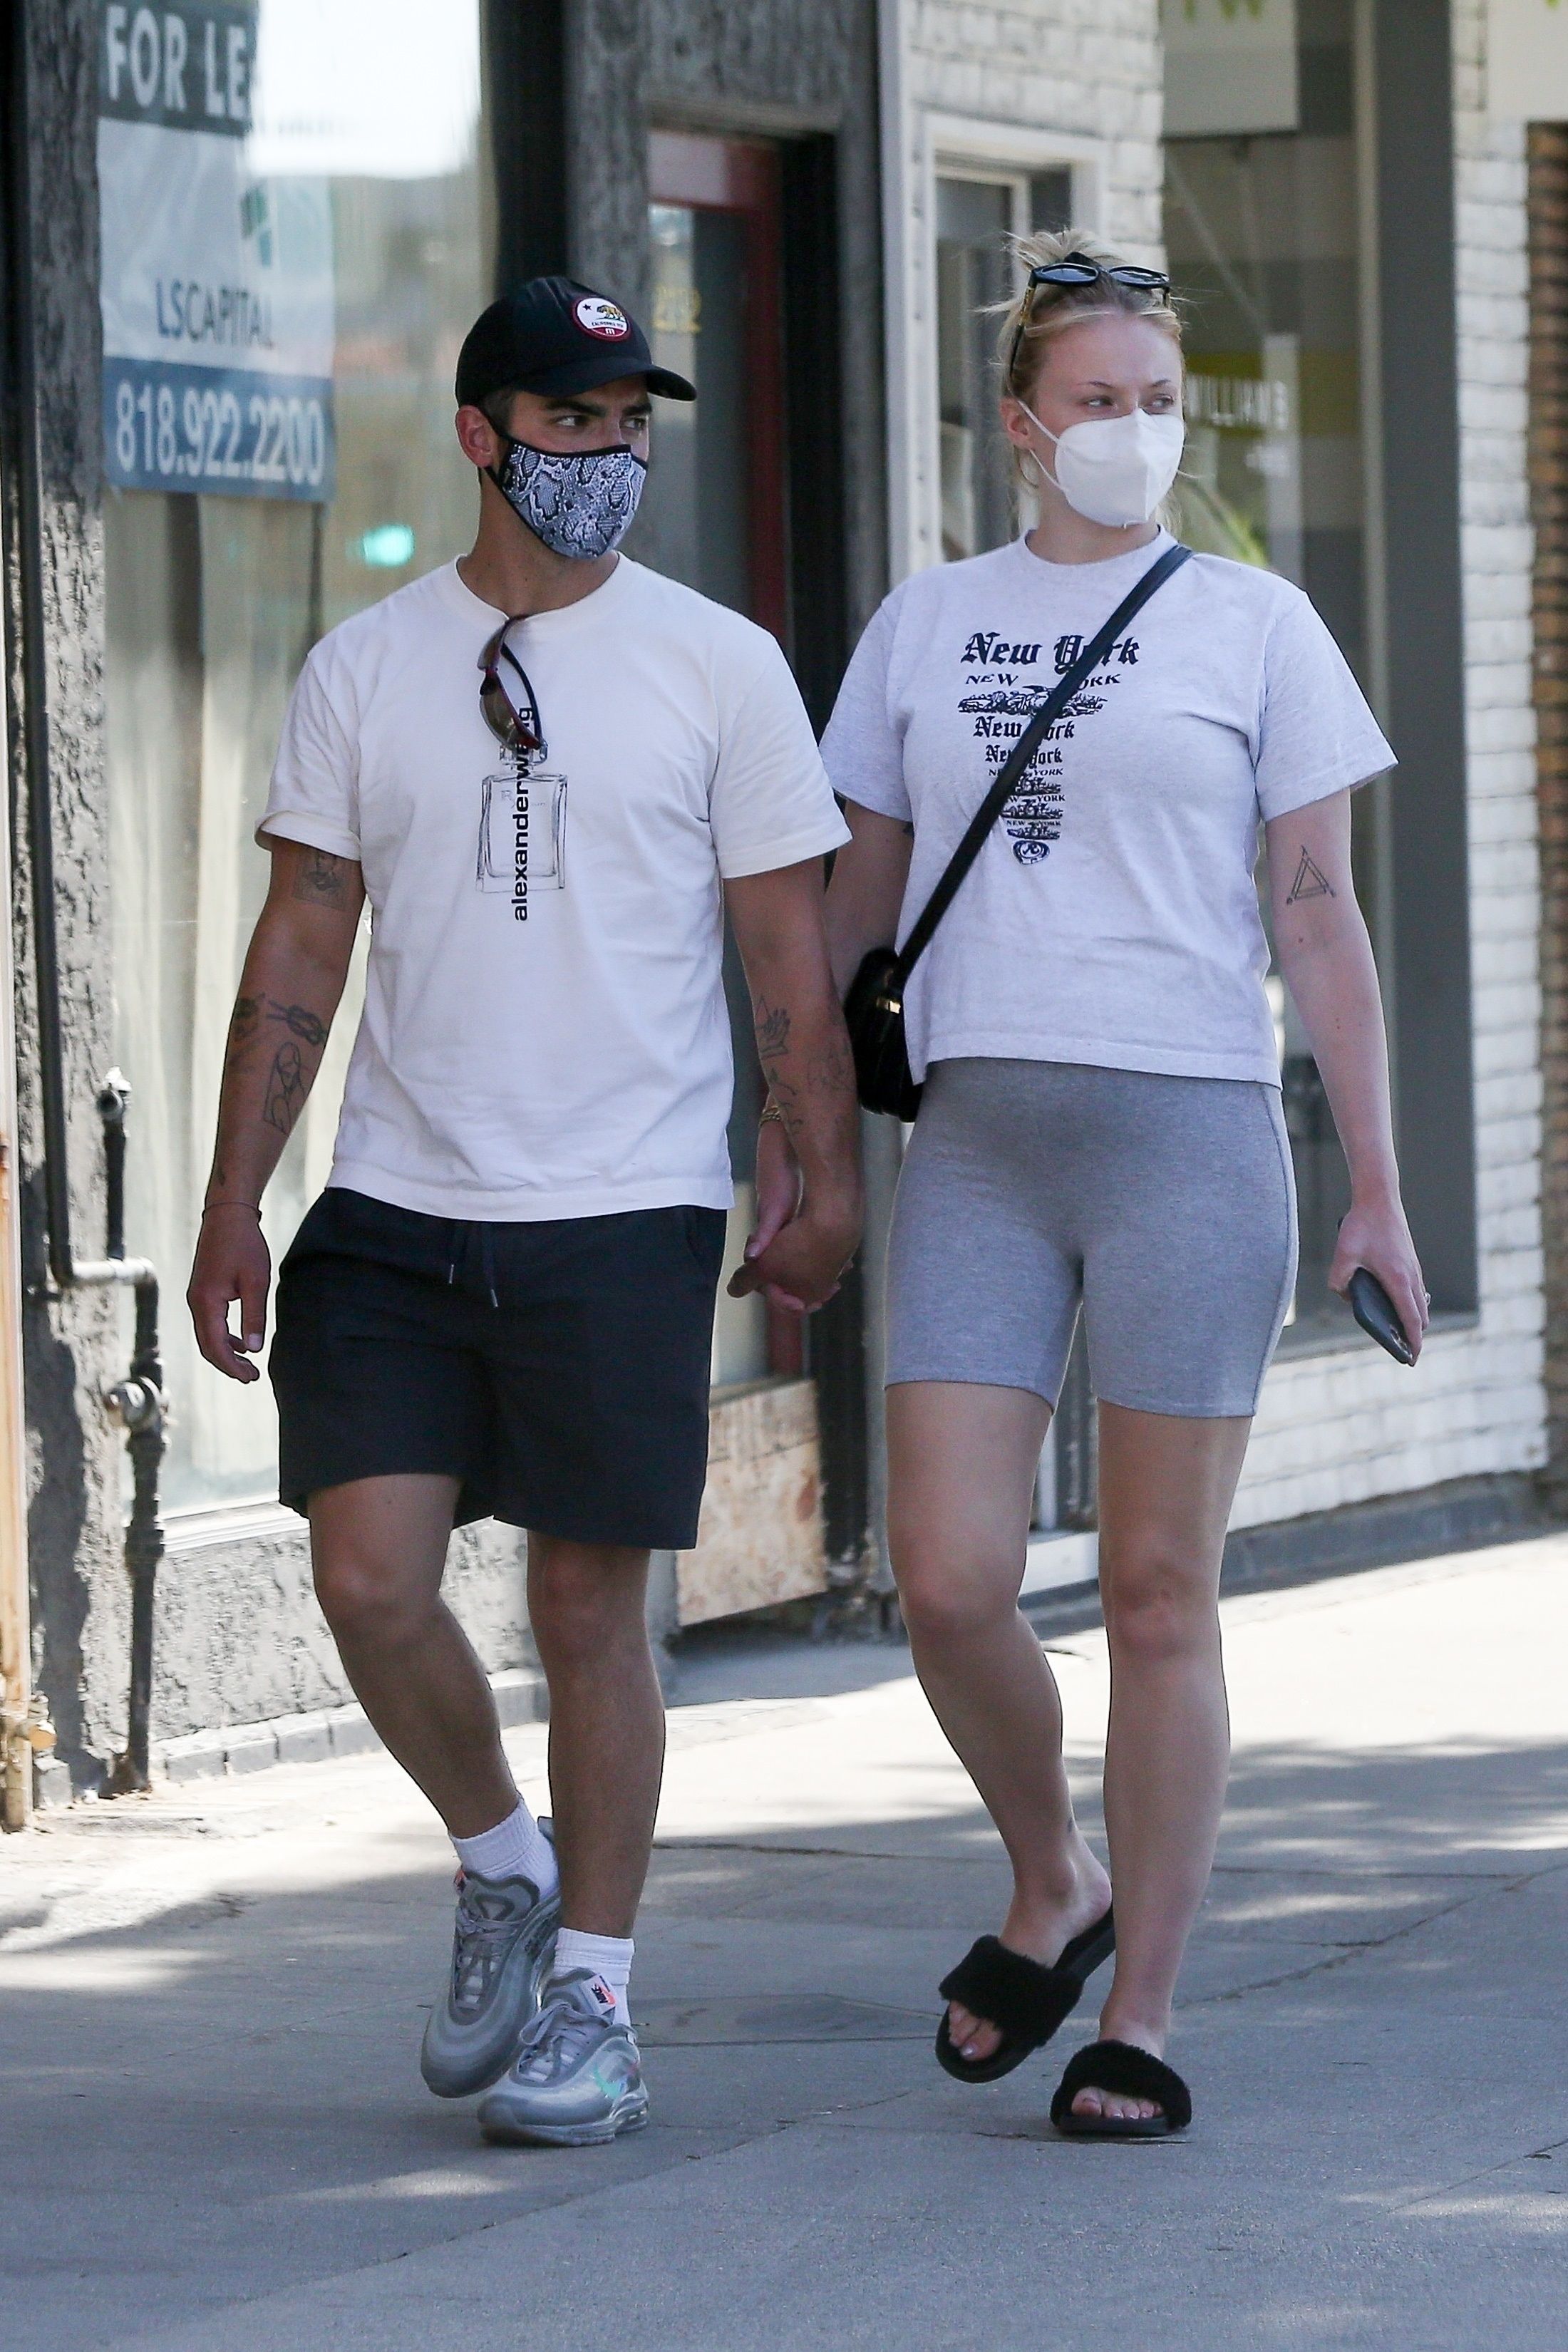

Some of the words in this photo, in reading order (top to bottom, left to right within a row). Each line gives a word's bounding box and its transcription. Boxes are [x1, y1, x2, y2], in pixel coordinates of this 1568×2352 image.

[107, 5, 187, 112] FOR
[116, 382, 324, 486] 818.922.2200
[960, 631, 1043, 665] New
[1053, 634, 1139, 675] Yrk
[965, 673, 1019, 686] NEW
[1077, 674, 1121, 691] ORK
[973, 716, 1022, 738] New
[1043, 721, 1075, 741] ork
[985, 744, 1011, 763] Ne
[1033, 768, 1063, 776] YORK
[511, 706, 535, 922] alexanderwag
